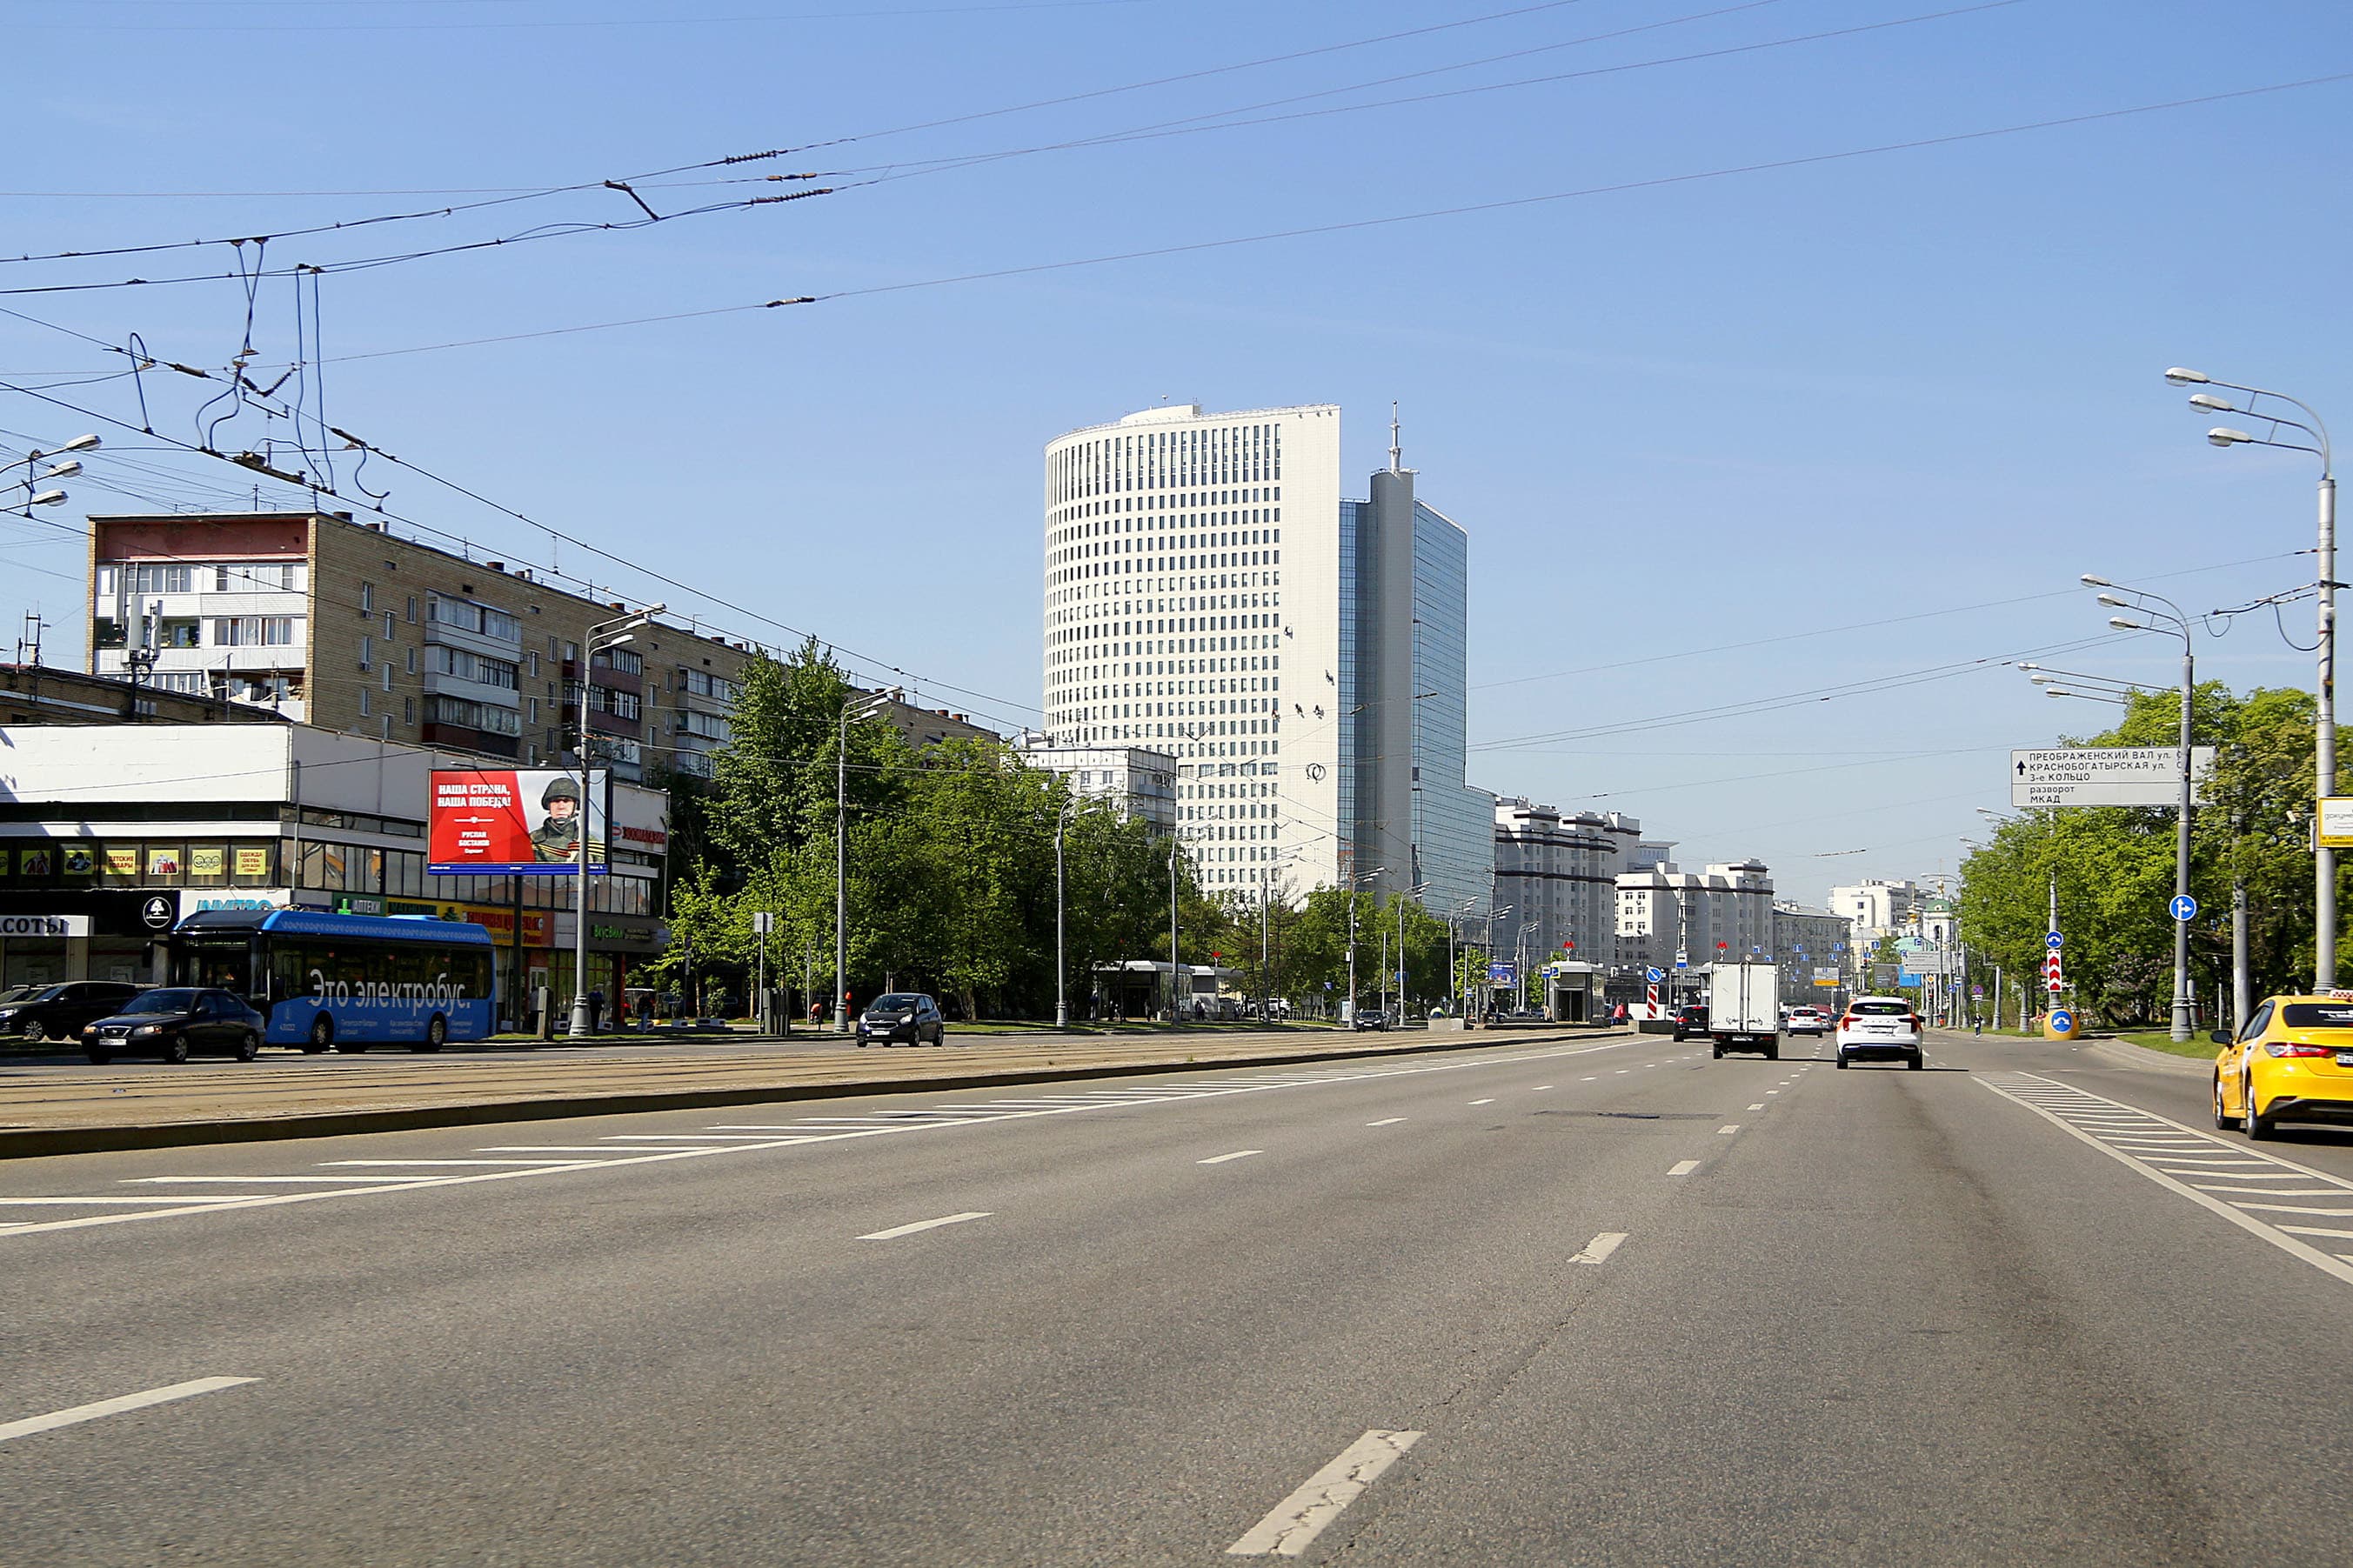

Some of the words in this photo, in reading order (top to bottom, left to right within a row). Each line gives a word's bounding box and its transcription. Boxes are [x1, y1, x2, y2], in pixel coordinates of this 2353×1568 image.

[2029, 750, 2129, 761] ПРЕОБРАЖЕНСКИЙ
[2132, 751, 2154, 759] ВАЛ
[2029, 762, 2149, 771] КРАСНОБОГАТЫРСКАЯ
[2048, 772, 2090, 781] КОЛЬЦО
[438, 784, 468, 795] НАША
[470, 784, 511, 796] СТРАНА,
[2029, 786, 2075, 795] разворот
[438, 797, 467, 807] НАША
[469, 797, 511, 809] ПОБЕДА!
[2030, 795, 2061, 804] МКАД
[0, 918, 67, 933] СОТЫ
[309, 969, 349, 1007] Это
[355, 972, 471, 1017] электробус.
